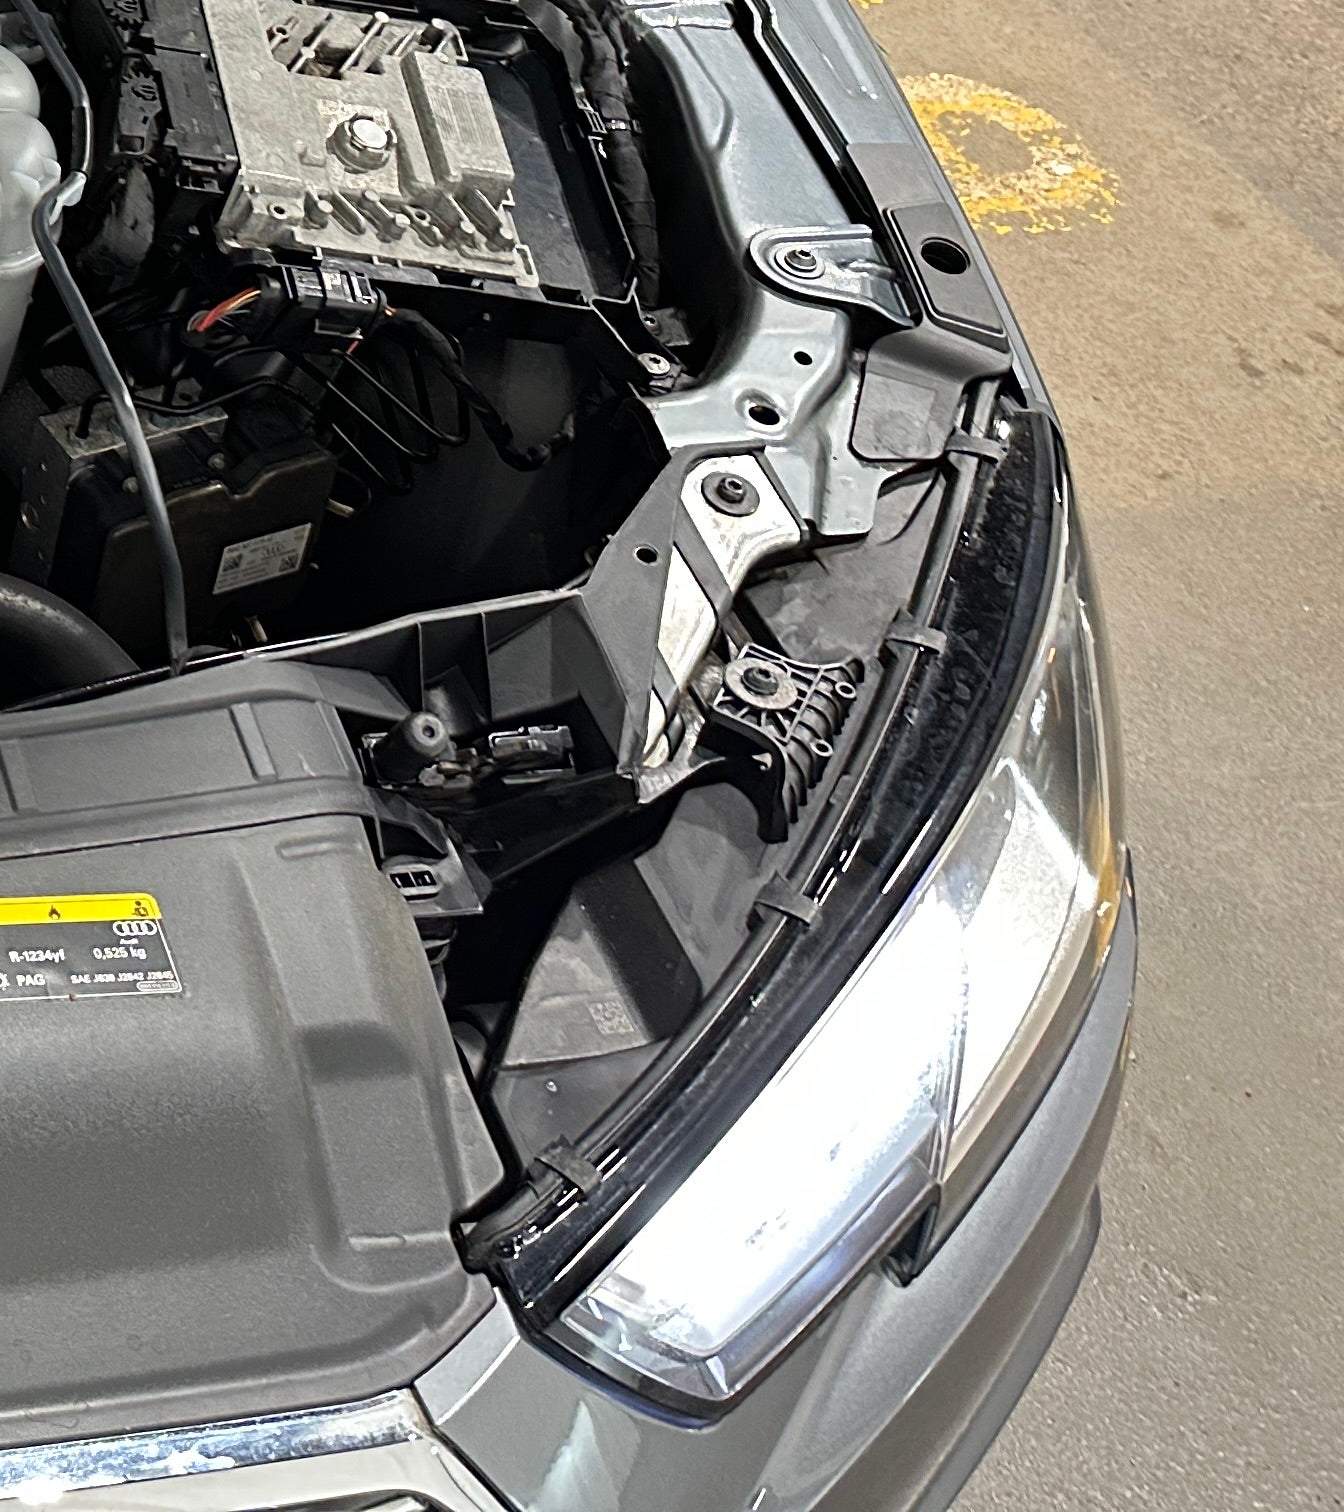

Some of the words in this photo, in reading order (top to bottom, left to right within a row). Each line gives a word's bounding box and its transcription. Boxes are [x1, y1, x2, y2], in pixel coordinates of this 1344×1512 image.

[9, 949, 65, 963] R-1234yf
[93, 947, 128, 960] 0,525
[130, 946, 147, 960] kg
[16, 974, 46, 986] PAG
[70, 974, 91, 984] SAE
